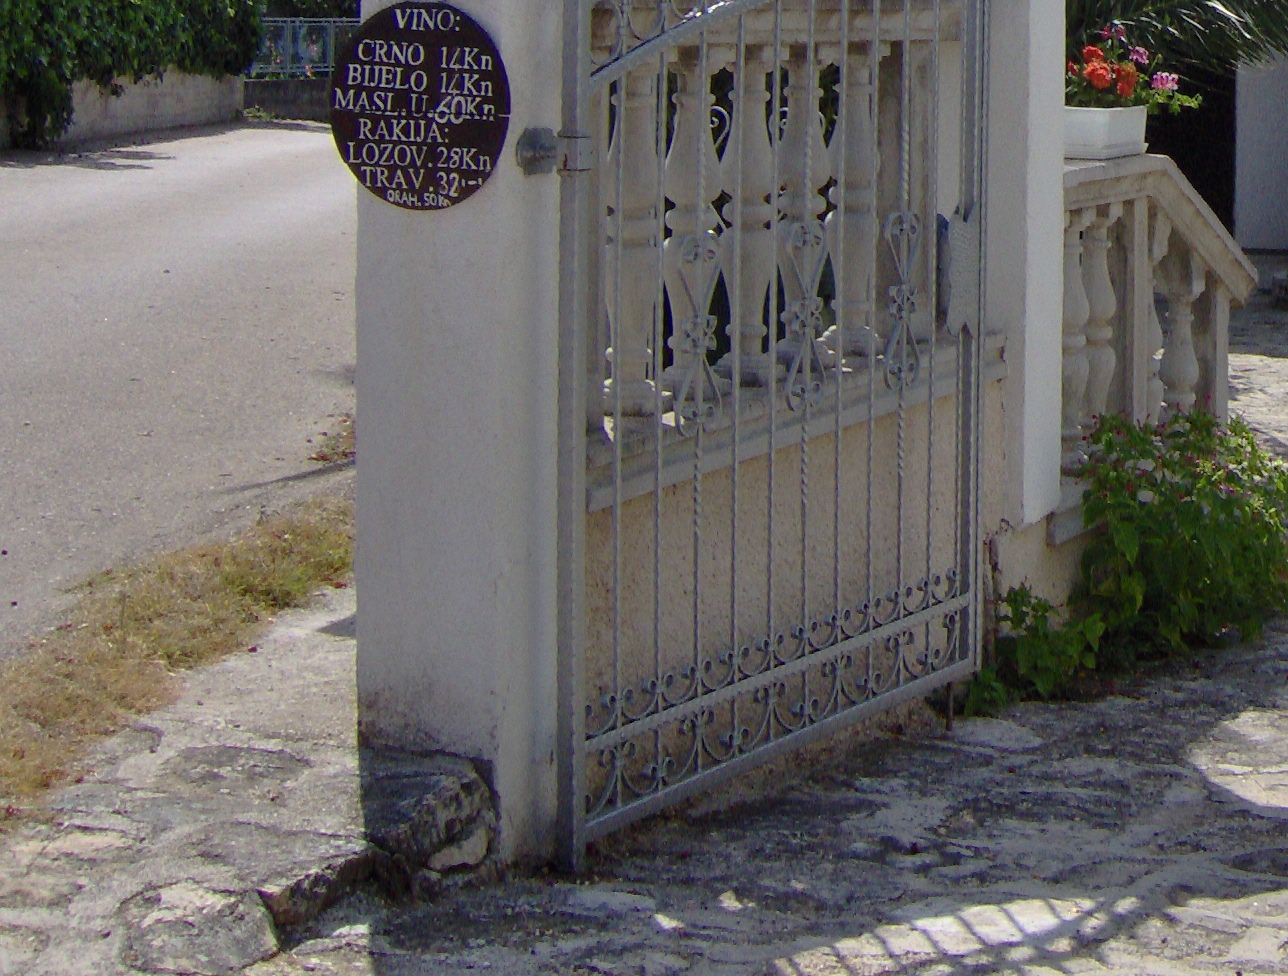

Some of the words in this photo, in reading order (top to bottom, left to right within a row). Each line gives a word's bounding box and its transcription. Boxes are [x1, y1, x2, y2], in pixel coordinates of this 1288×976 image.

[395, 8, 461, 32] VINO:
[358, 39, 425, 66] CRNO
[440, 46, 493, 71] 14Kn
[347, 64, 428, 93] BIJELO
[440, 72, 493, 97] 14Kn
[334, 88, 407, 116] MASL.
[358, 118, 449, 143] RAKIJA:
[347, 141, 433, 168] LOZOV.
[436, 146, 492, 173] 28Kn
[360, 166, 434, 193] TRAV.
